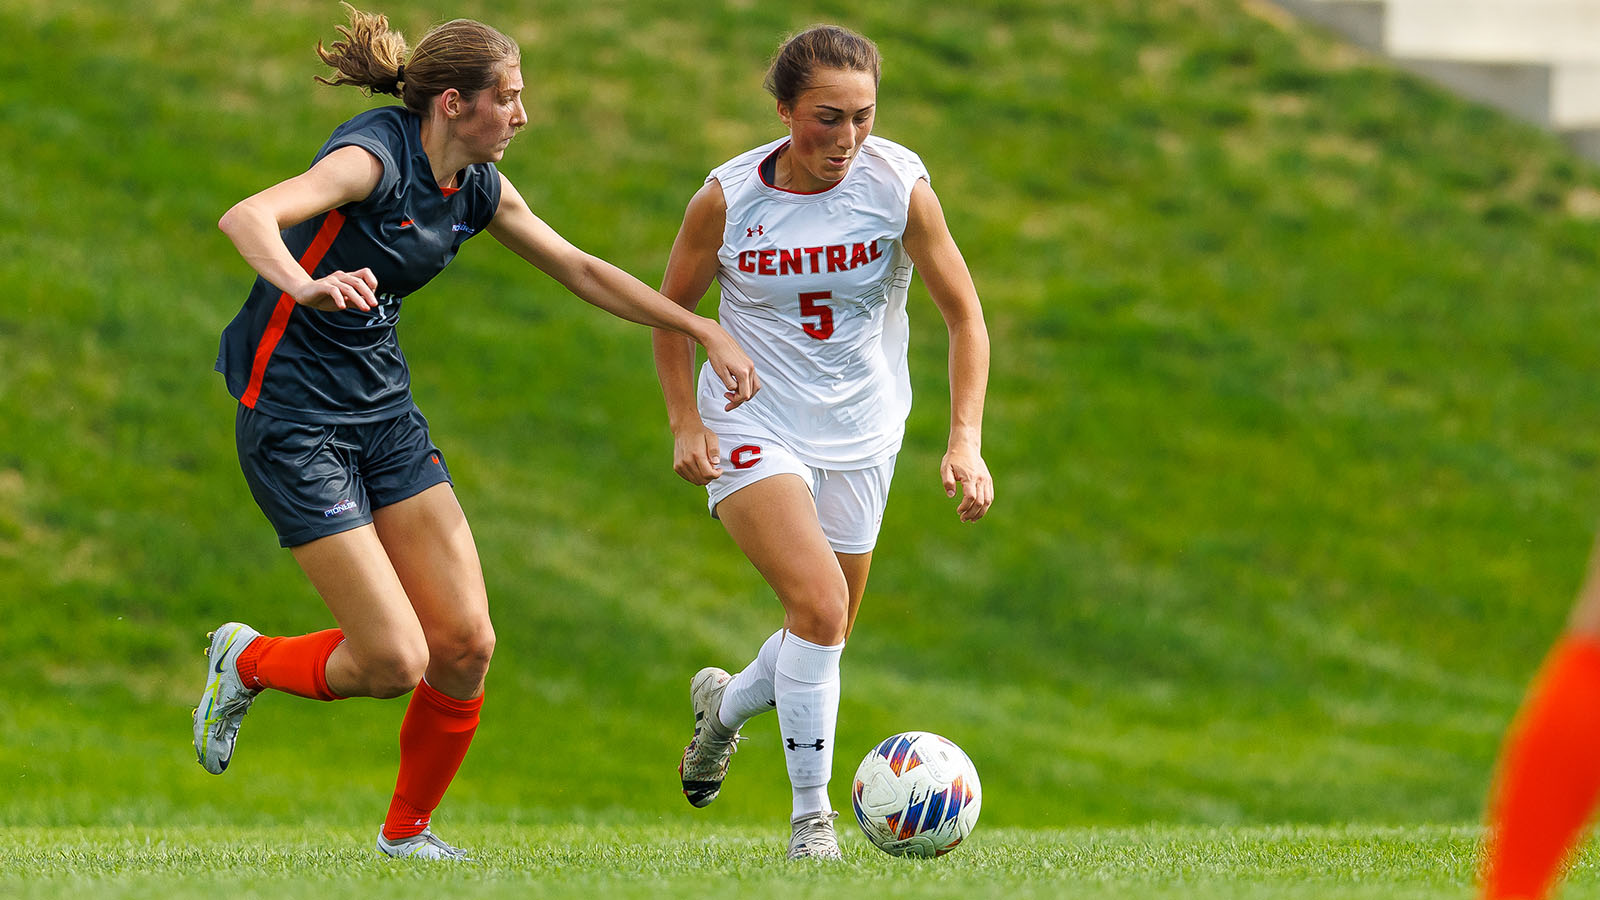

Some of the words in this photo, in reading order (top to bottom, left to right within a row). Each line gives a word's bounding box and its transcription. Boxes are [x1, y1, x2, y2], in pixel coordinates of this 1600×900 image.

[738, 240, 883, 276] CENTRAL
[798, 290, 835, 341] 5
[729, 443, 763, 470] C
